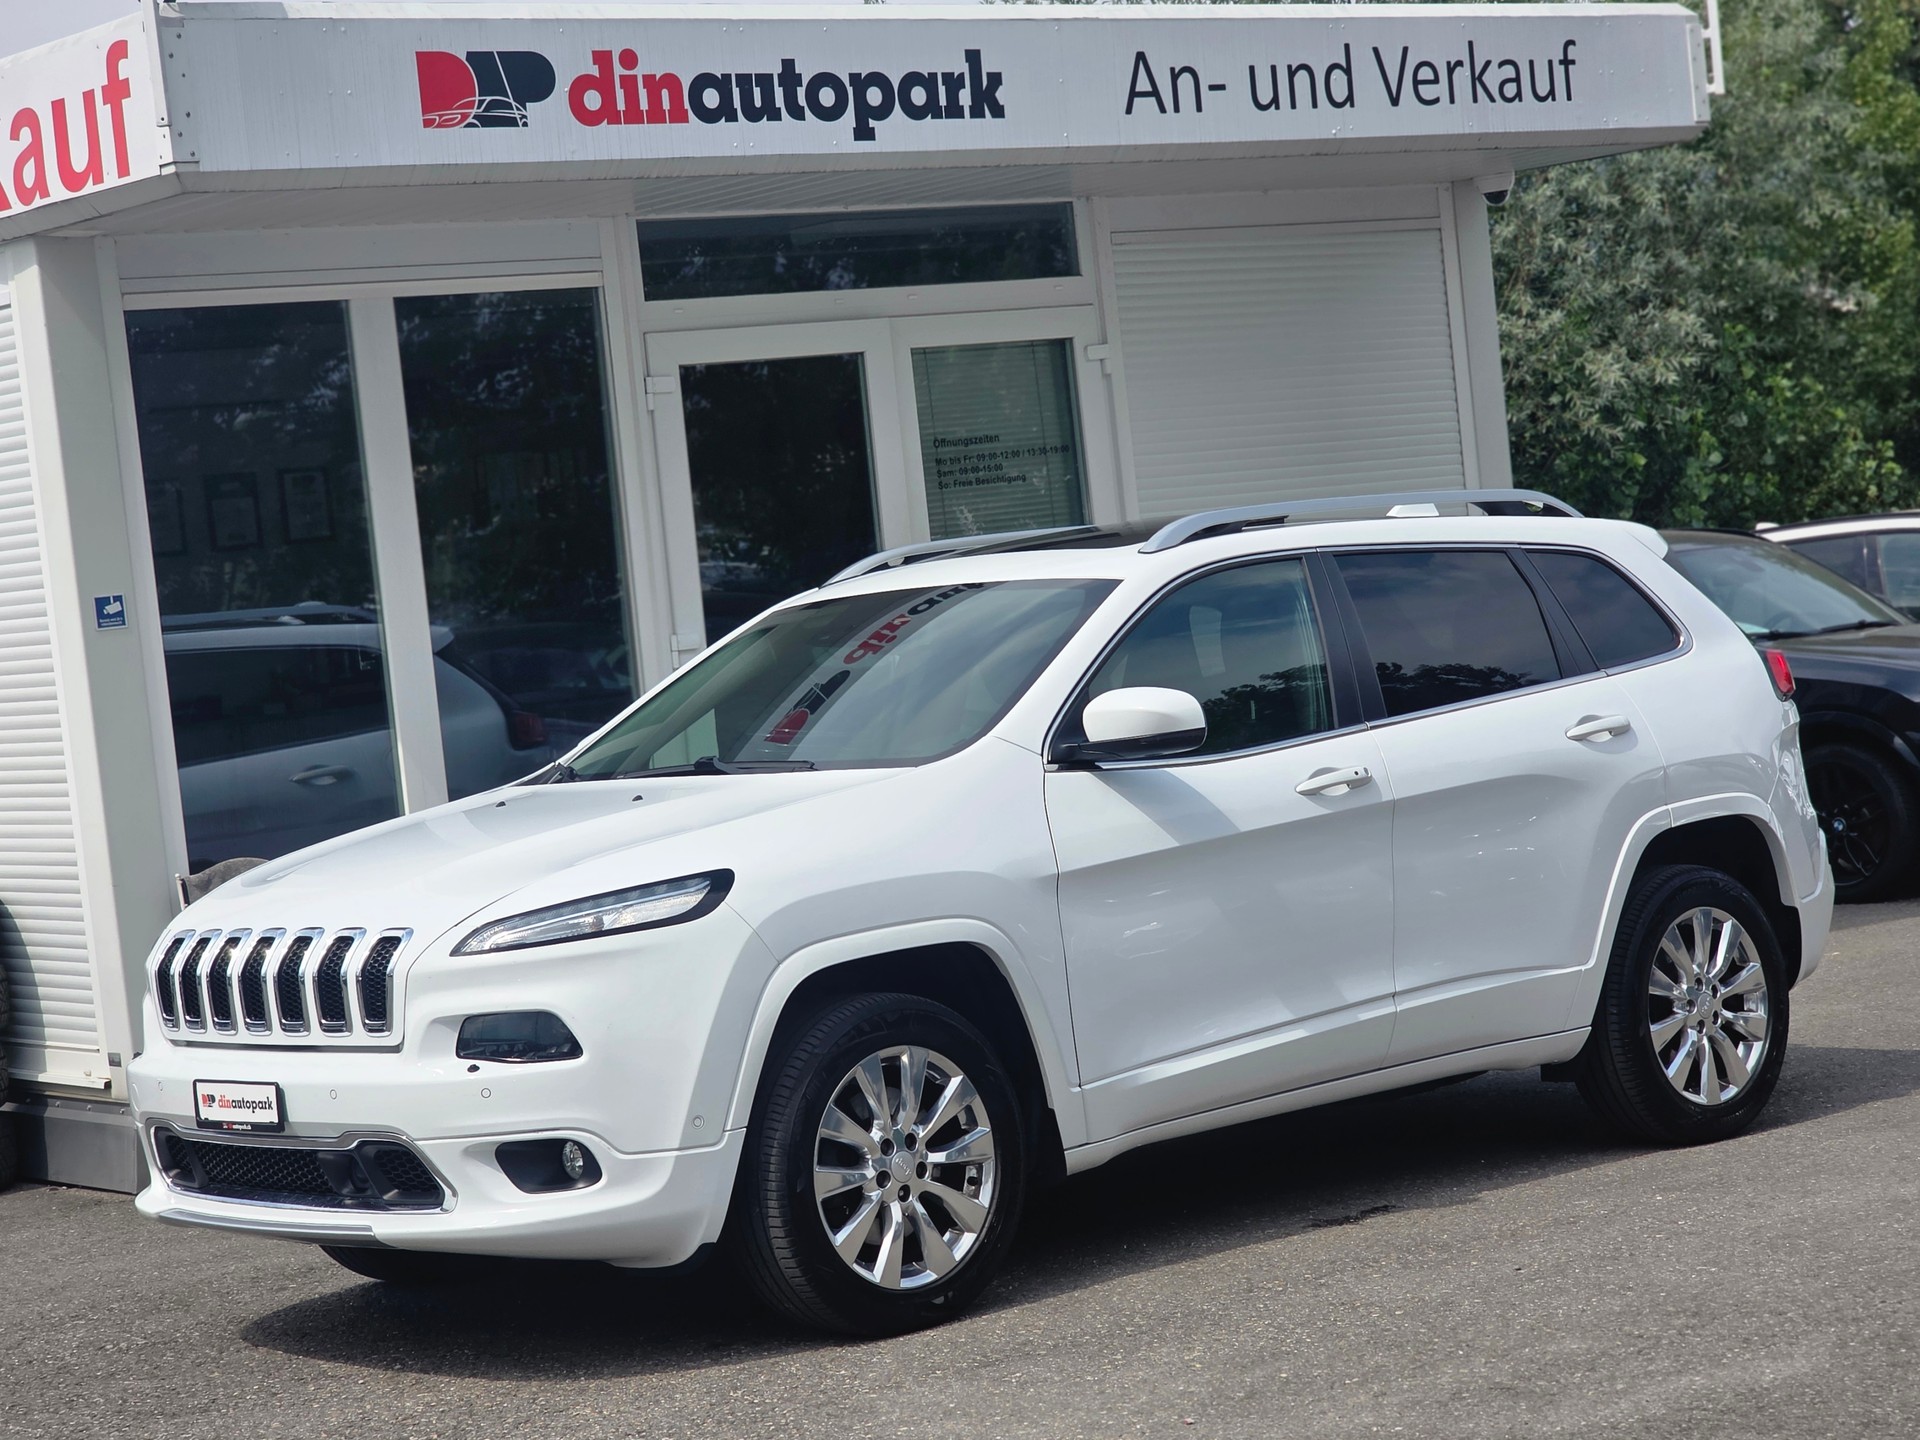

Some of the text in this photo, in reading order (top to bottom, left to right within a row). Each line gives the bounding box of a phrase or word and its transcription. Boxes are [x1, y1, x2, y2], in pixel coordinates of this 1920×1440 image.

[568, 48, 1005, 141] dinautopark
[1125, 39, 1577, 115] An- und Verkauf
[0, 39, 131, 212] auf
[935, 457, 948, 466] Mo
[949, 455, 962, 465] bis
[953, 478, 974, 489] Freie
[975, 474, 1027, 487] Besichtigung
[218, 1095, 273, 1113] dinautopark
